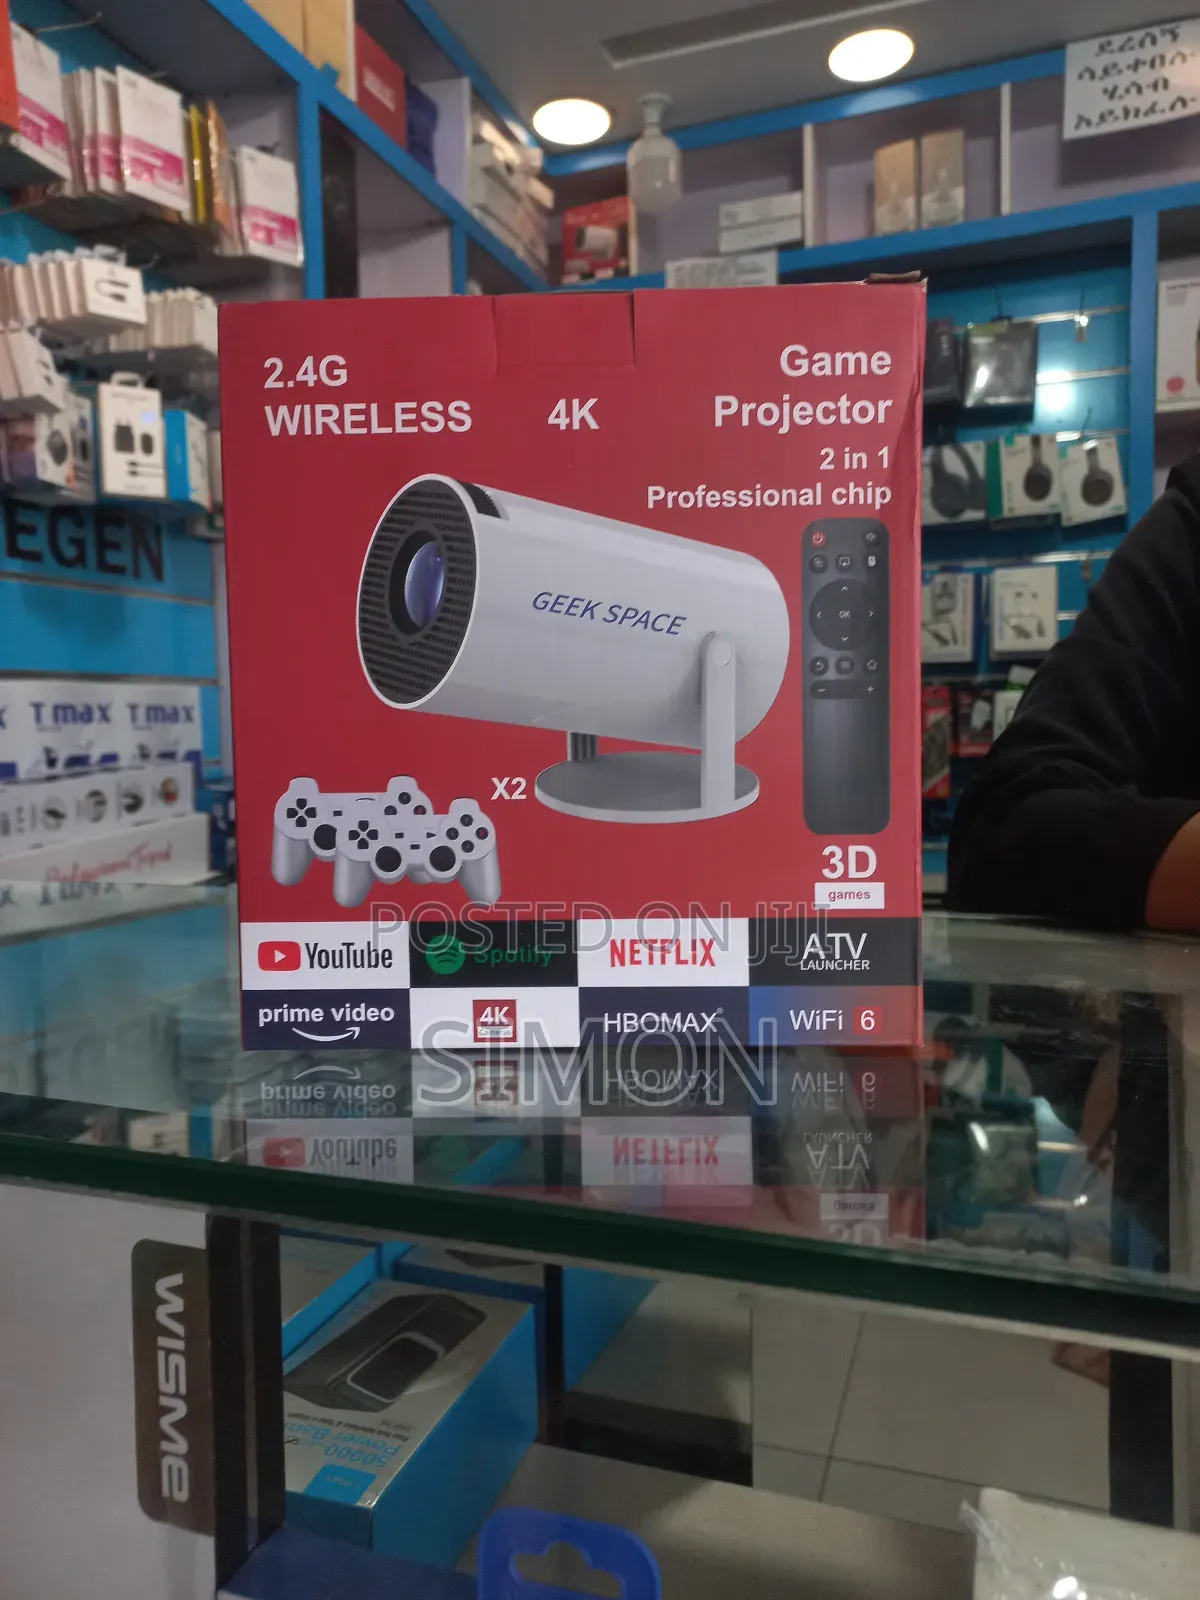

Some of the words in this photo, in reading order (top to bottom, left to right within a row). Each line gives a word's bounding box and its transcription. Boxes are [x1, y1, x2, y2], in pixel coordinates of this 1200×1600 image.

[264, 355, 348, 389] 2.4G
[780, 344, 892, 377] Game
[264, 400, 473, 437] WIRELESS
[548, 398, 600, 431] 4K
[714, 394, 893, 434] Projector
[819, 448, 836, 470] 2
[844, 446, 868, 469] in
[877, 446, 889, 469] 1
[647, 482, 823, 509] Professional
[831, 481, 892, 511] chip
[532, 591, 604, 620] GEEK
[602, 604, 688, 636] SPACE
[838, 610, 851, 619] OK
[490, 776, 528, 801] X2
[821, 845, 878, 879] 3D
[828, 889, 871, 902] games
[304, 941, 393, 969] YouTube
[474, 944, 552, 967] Spotify
[609, 938, 716, 968] NETFLIX
[802, 933, 867, 960] ATV
[800, 959, 870, 971] LAUNCHER
[258, 1004, 324, 1027] prime
[333, 1003, 395, 1023] video
[479, 1006, 510, 1025] 4K
[603, 1012, 718, 1033] HBOMAX
[790, 1009, 843, 1031] WiFi
[860, 1010, 876, 1031] 6
[284, 1421, 330, 1442] Ban
